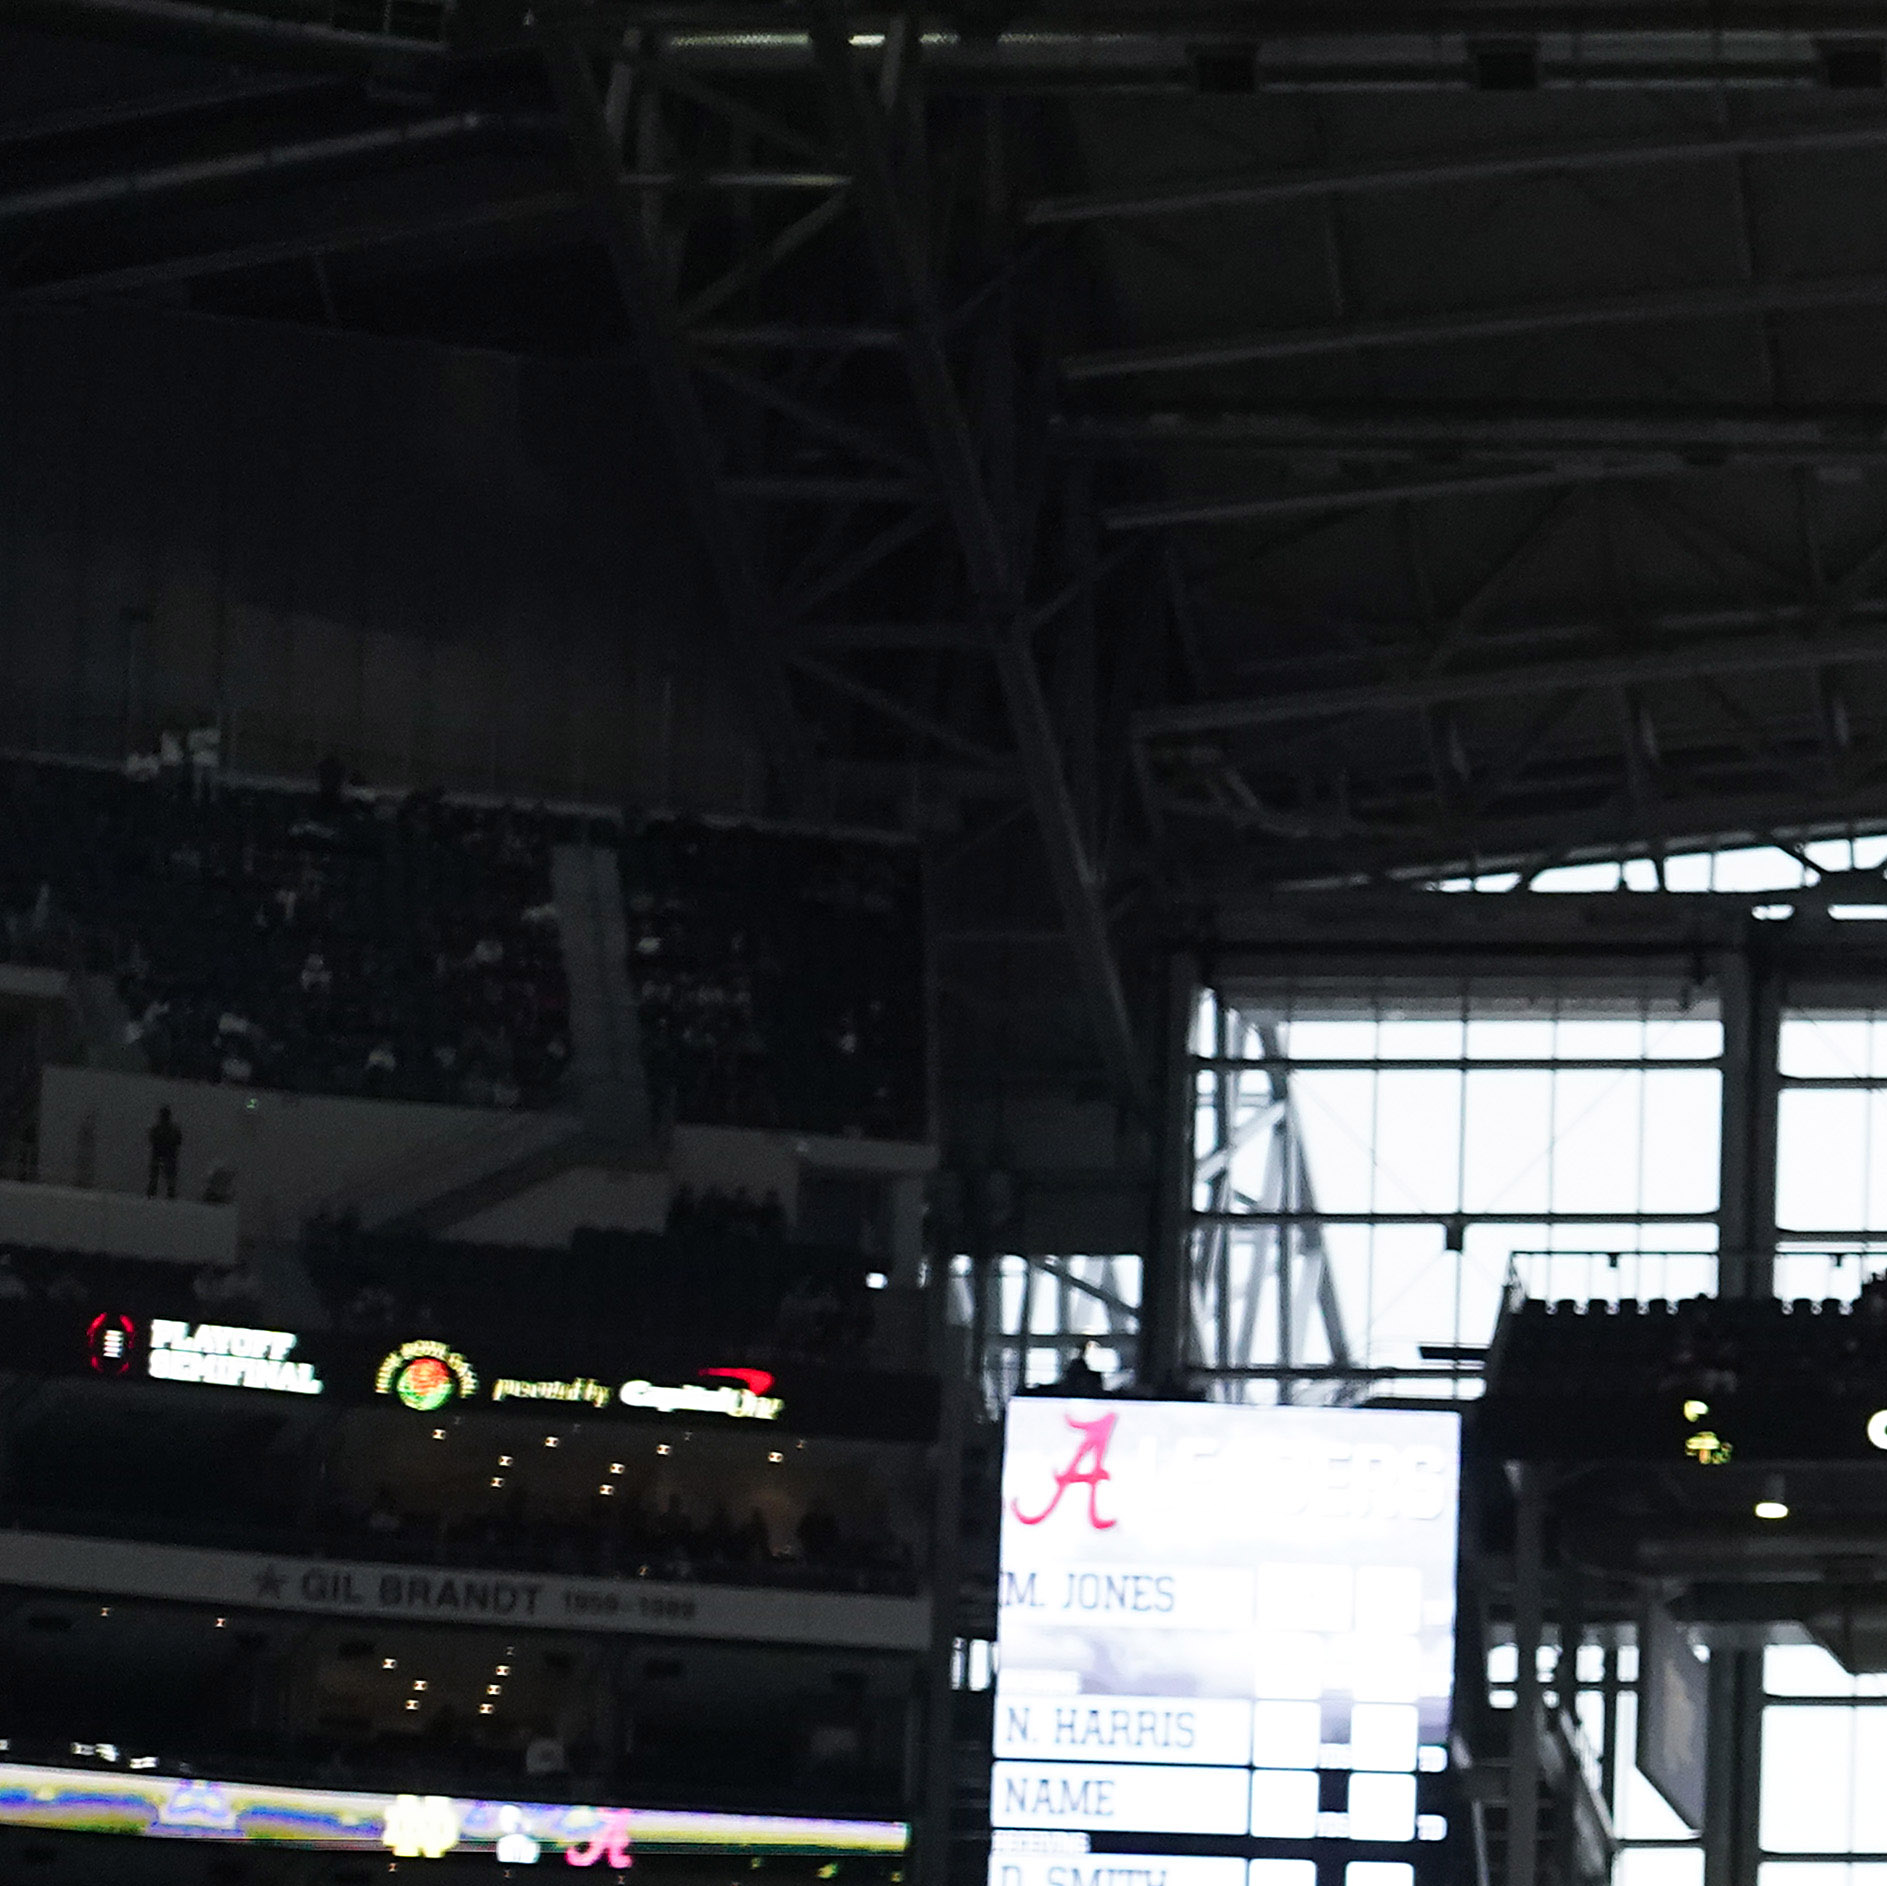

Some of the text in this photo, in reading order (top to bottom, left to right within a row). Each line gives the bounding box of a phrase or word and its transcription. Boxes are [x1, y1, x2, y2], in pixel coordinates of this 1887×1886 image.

[300, 1567, 363, 1603] GIL
[379, 1574, 543, 1616] BRANDT
[1062, 1573, 1176, 1613] JONES
[1004, 1707, 1197, 1749] N. HARRIS
[1003, 1776, 1117, 1817] NAME
